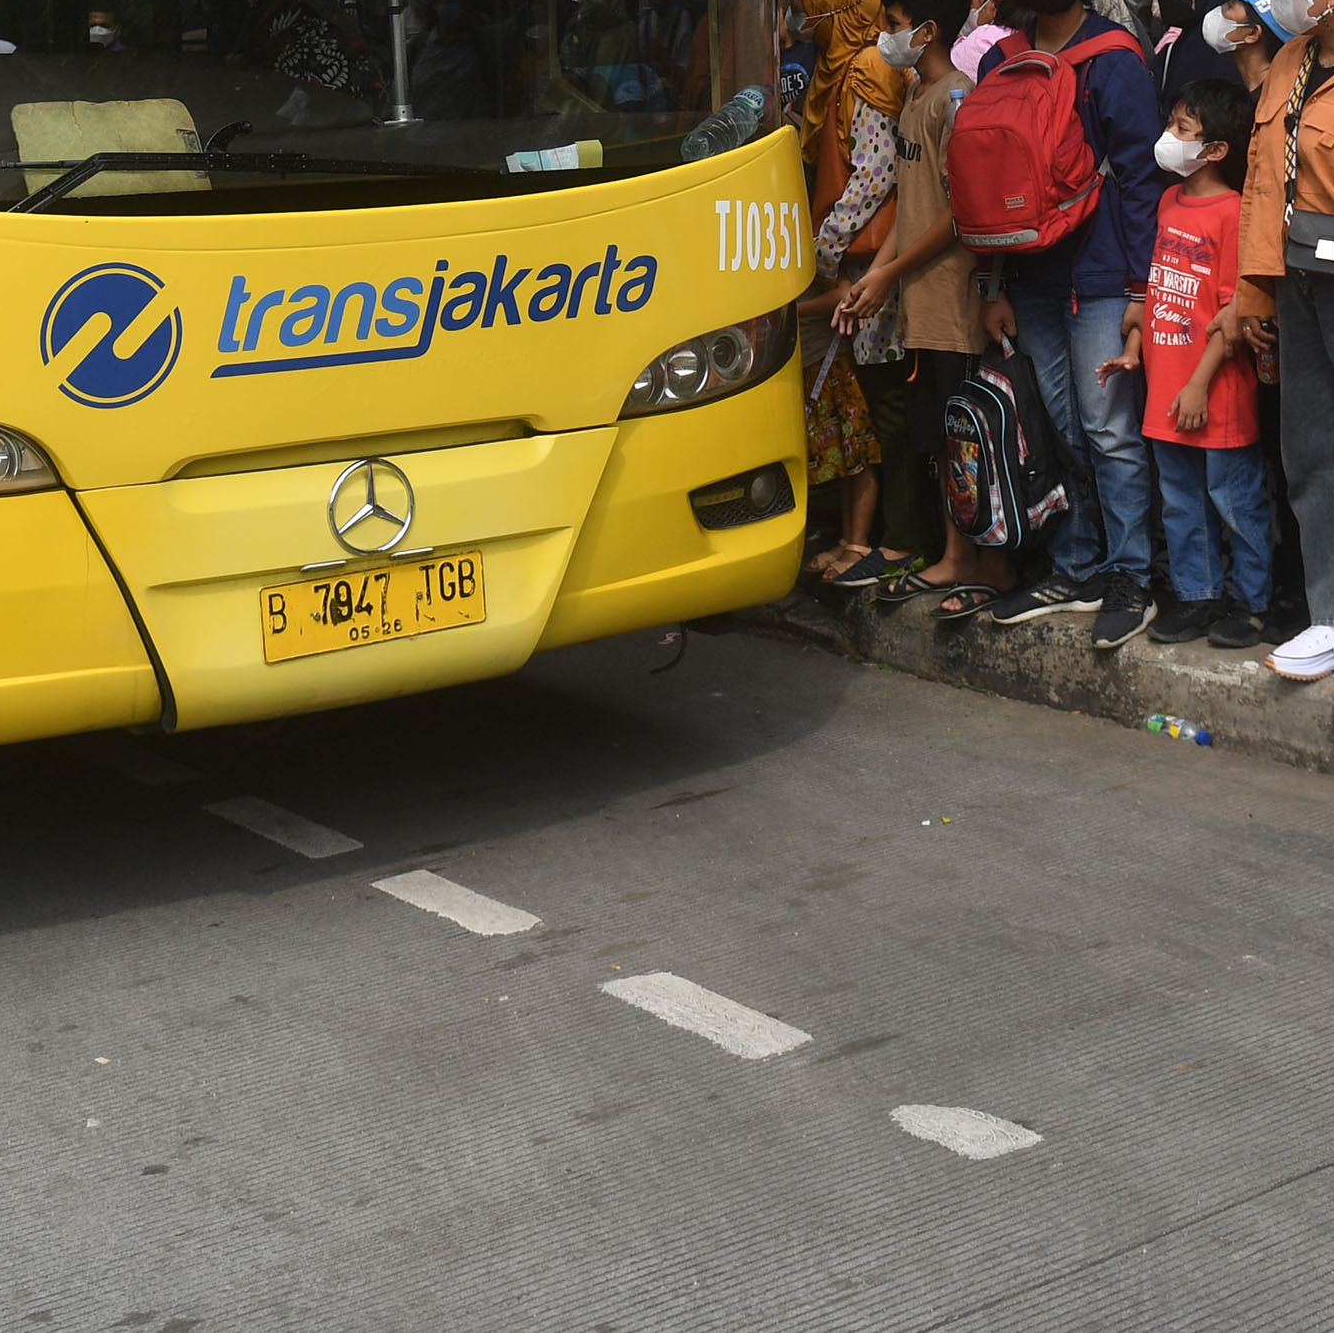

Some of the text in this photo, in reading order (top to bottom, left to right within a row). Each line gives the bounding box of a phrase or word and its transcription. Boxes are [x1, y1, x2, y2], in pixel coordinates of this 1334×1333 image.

[715, 200, 803, 272] TJ0351
[211, 244, 657, 378] transjakarta
[1163, 270, 1200, 296] VARSITY
[268, 594, 287, 635] B
[419, 558, 476, 606] TGB
